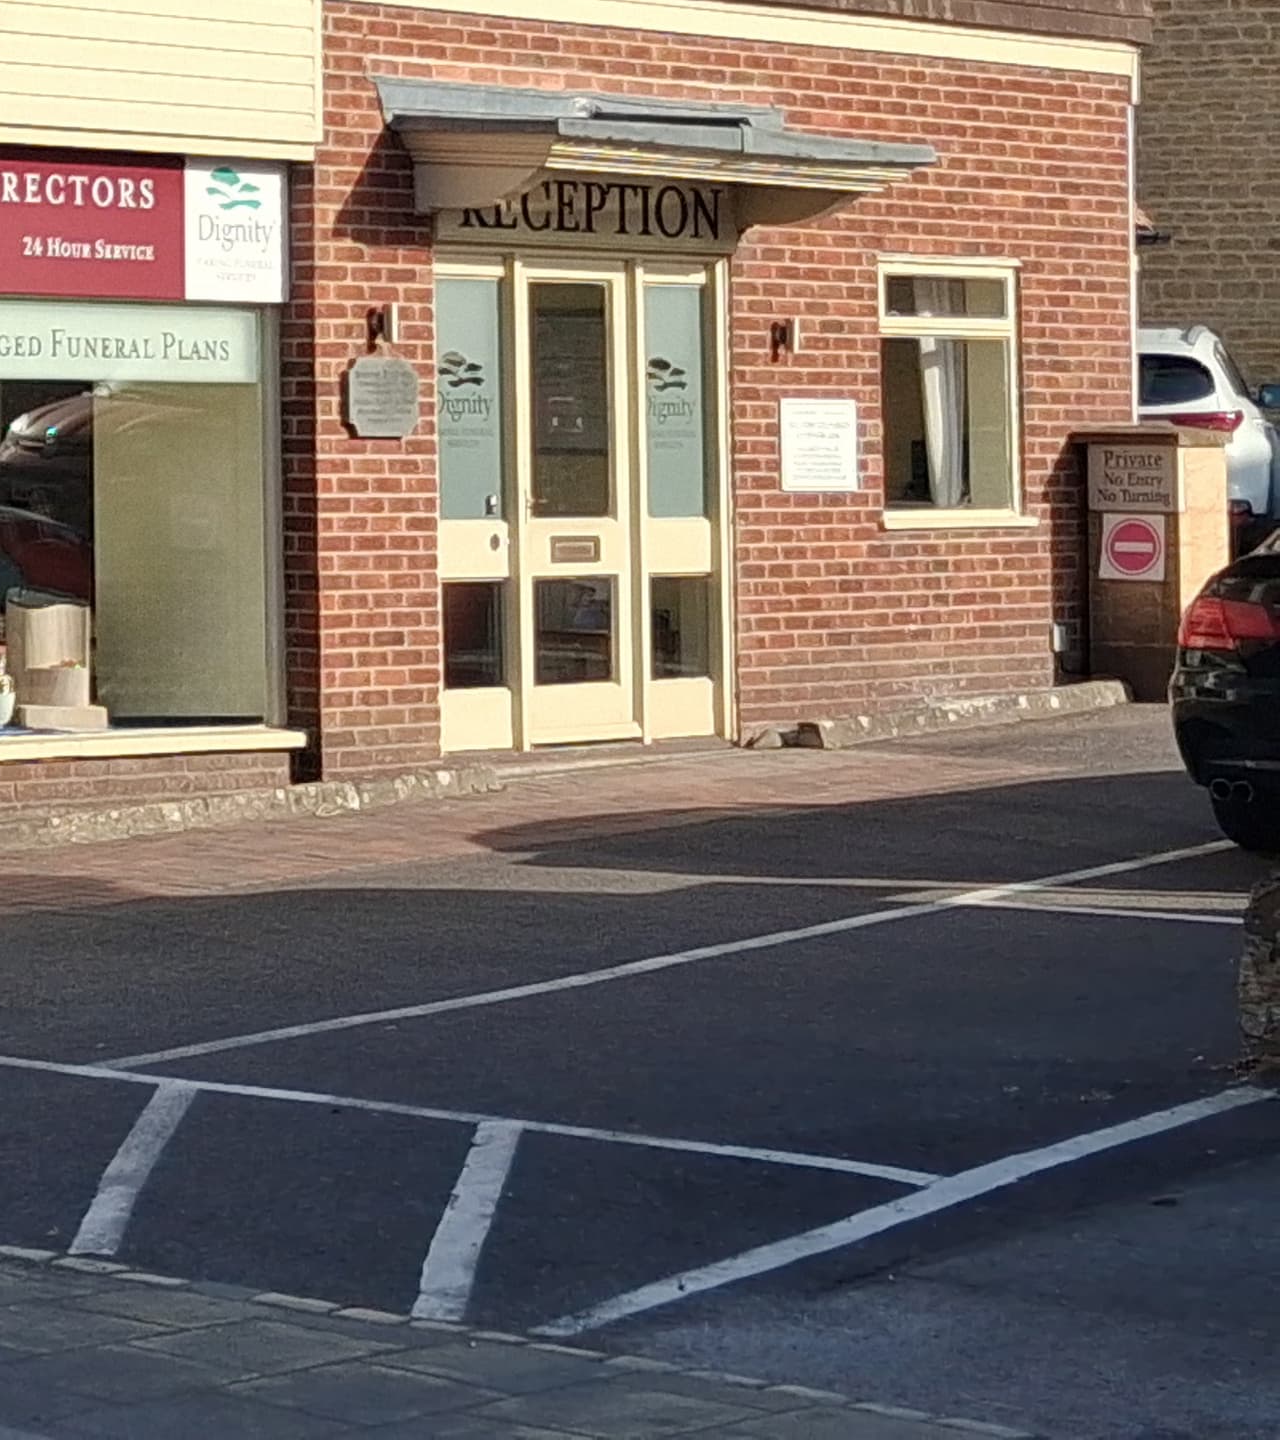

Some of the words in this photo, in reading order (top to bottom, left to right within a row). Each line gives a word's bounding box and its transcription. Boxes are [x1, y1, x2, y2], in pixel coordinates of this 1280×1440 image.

[199, 214, 273, 253] Dignity
[22, 237, 42, 257] 24
[47, 238, 91, 259] HOUR
[94, 239, 155, 261] SERVICE
[50, 329, 155, 360] FUNERAL
[162, 332, 230, 361] PLANS
[1103, 450, 1163, 467] Private
[1104, 471, 1123, 486] No
[1128, 472, 1163, 487] Entry
[1097, 488, 1116, 502] No
[1120, 489, 1171, 507] Turning
